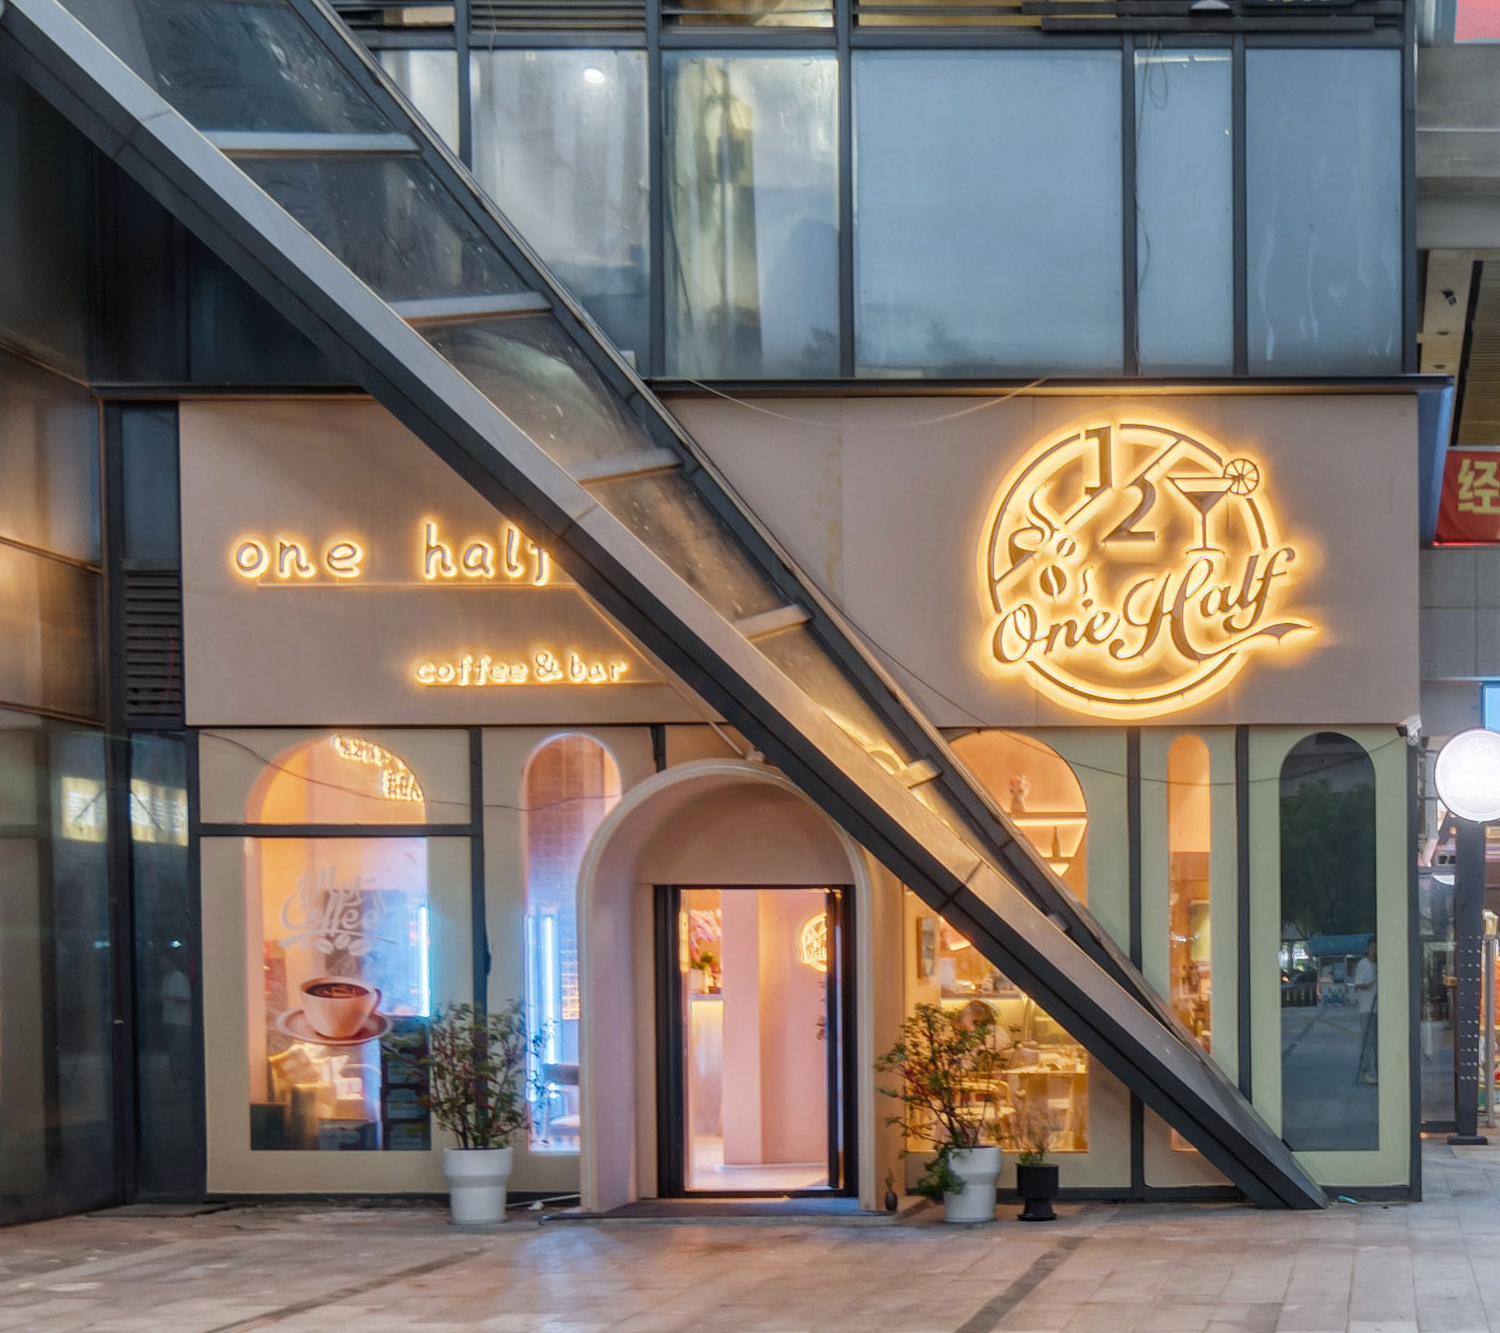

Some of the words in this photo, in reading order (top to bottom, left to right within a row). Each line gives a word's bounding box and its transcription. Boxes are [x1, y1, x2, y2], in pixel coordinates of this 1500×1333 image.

[235, 538, 362, 576] one
[992, 603, 1120, 664] One
[1109, 546, 1300, 661] Half
[415, 652, 528, 686] coffee
[569, 650, 628, 682] bar
